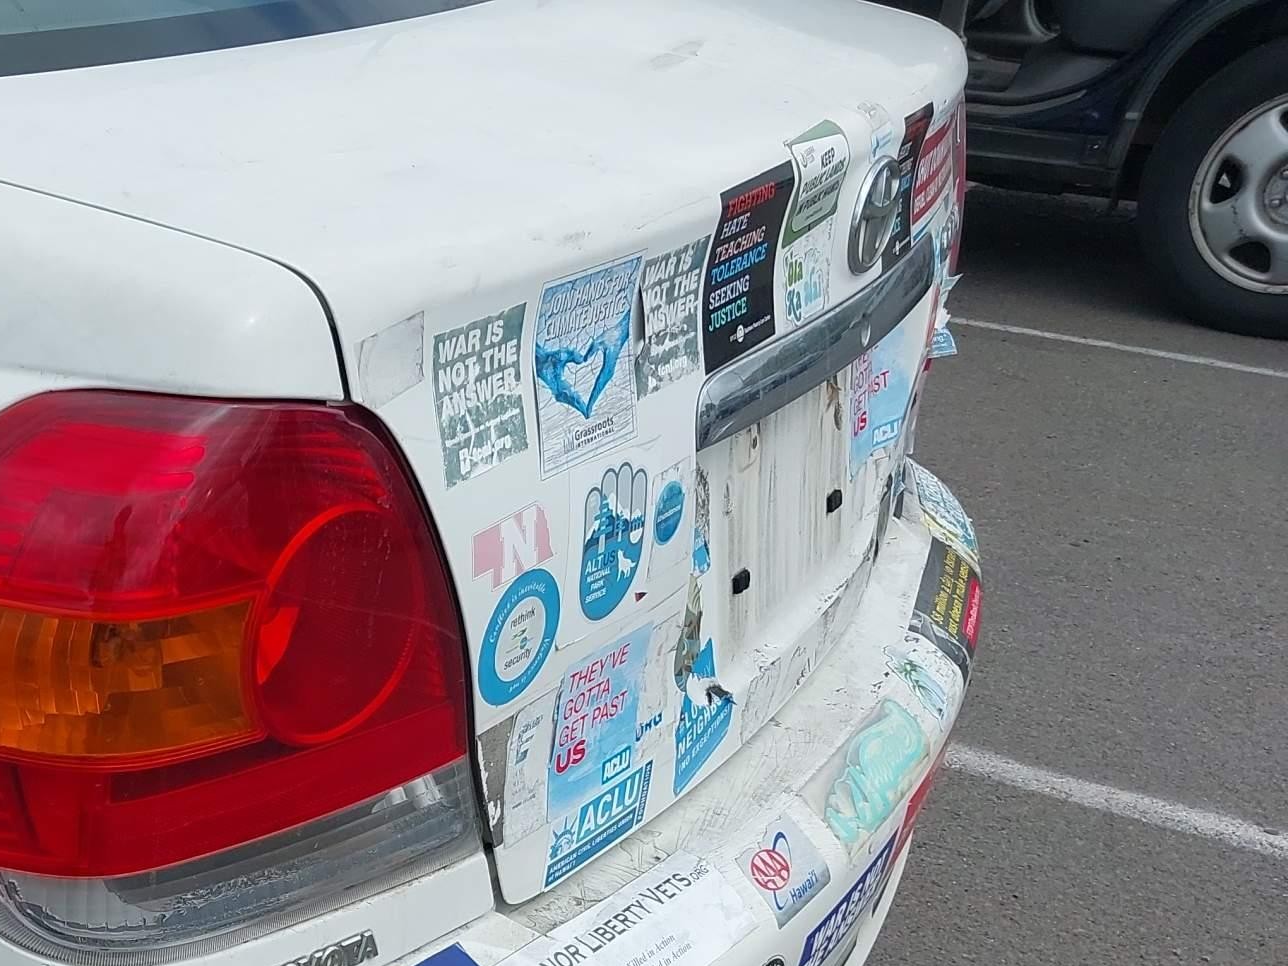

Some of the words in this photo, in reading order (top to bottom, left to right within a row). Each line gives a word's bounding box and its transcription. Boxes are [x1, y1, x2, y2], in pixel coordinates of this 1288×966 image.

[821, 147, 835, 169] KEEP
[727, 181, 776, 218] FIGHTING
[720, 212, 751, 240] HATE
[715, 226, 766, 264] TEACHING
[644, 256, 677, 289] WAR
[678, 246, 693, 273] IS
[711, 243, 768, 285] TOLERANCE
[549, 288, 578, 319] JOIN
[576, 278, 611, 308] HANDS
[643, 282, 670, 313] NOT
[674, 268, 700, 298] THE
[709, 275, 750, 310] SEEKING
[545, 306, 590, 341] CLIMATE
[587, 293, 628, 326] JUSTICE
[708, 297, 747, 332] JUSTICE
[439, 329, 481, 364] WAR
[485, 319, 504, 346] IS
[438, 356, 479, 393] NOT
[482, 339, 518, 374] THE
[441, 367, 518, 419] ANSWER
[574, 416, 614, 441] Grassroots
[586, 567, 611, 583] NATIONAL
[590, 579, 604, 591] PARK
[585, 587, 607, 603] SERVICE
[510, 606, 536, 630] rethink
[503, 647, 533, 671] security
[570, 643, 630, 693] THEY'VE
[563, 678, 610, 721] GOTTA
[559, 713, 588, 747] GET
[591, 690, 628, 729] PAST
[555, 739, 586, 774] US
[603, 748, 630, 783] ACLU
[578, 773, 640, 841] ACLU
[549, 853, 578, 874] AMERICAN
[751, 850, 790, 889] AAA
[574, 899, 653, 954] LIBERTY
[647, 950, 655, 959] in
[655, 934, 676, 953] Action
[663, 957, 672, 966] in
[671, 943, 692, 961] Action
